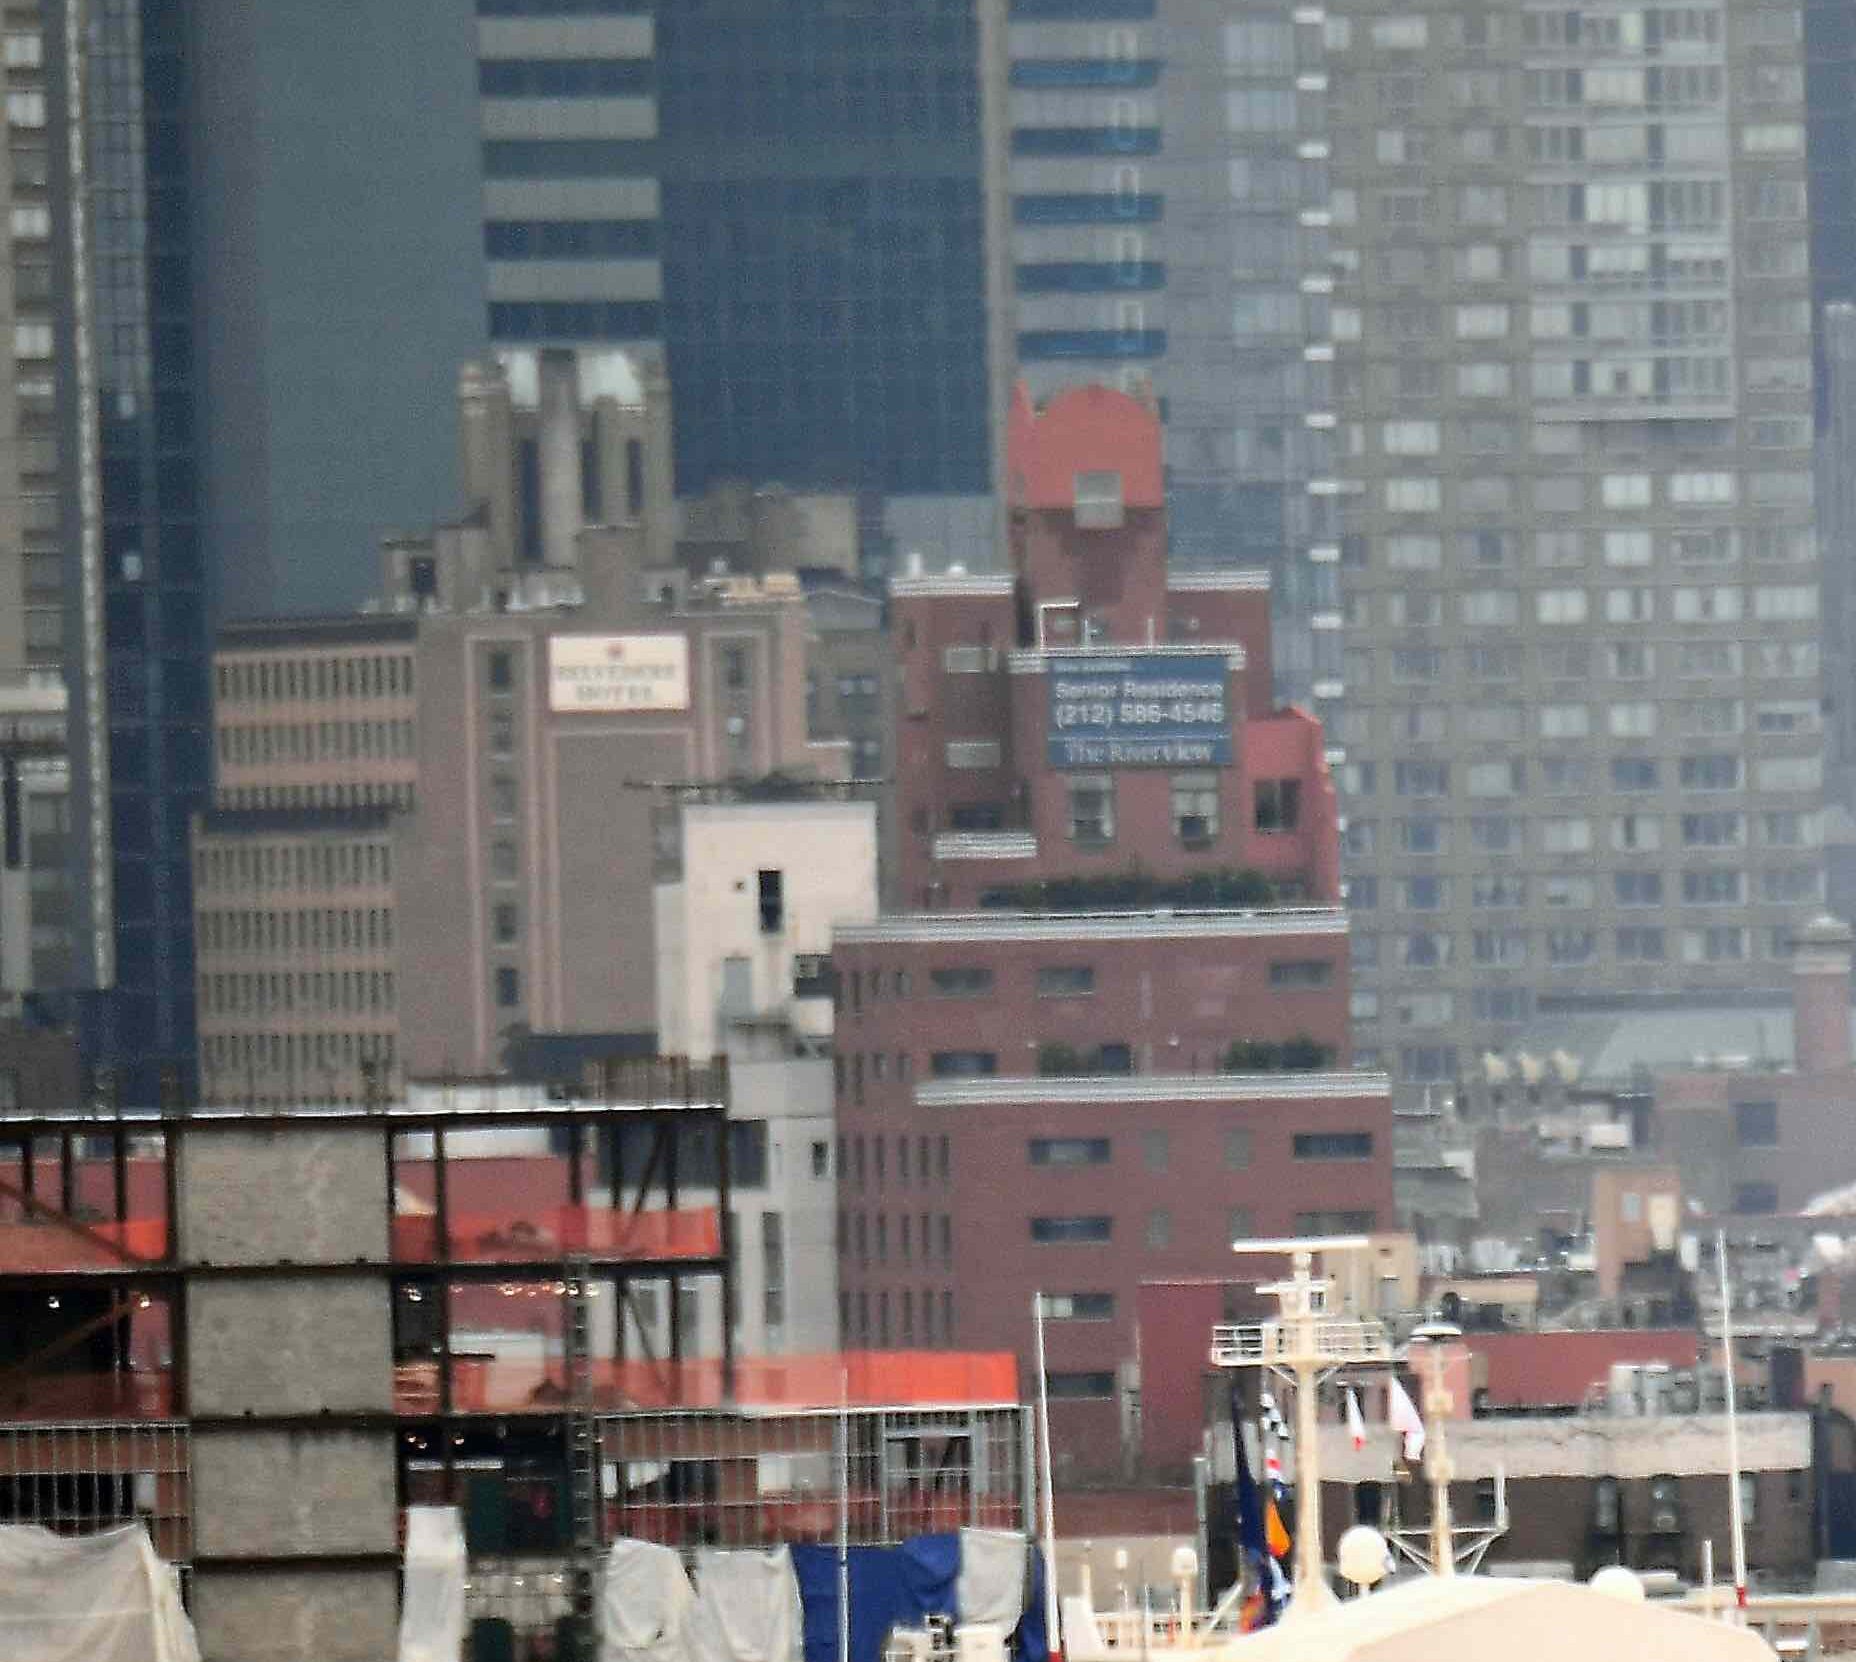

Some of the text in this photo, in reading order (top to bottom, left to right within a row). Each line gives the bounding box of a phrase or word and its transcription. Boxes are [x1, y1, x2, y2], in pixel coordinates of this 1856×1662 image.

[1055, 679, 1224, 699] Senior Residence
[1055, 703, 1114, 729] (212)
